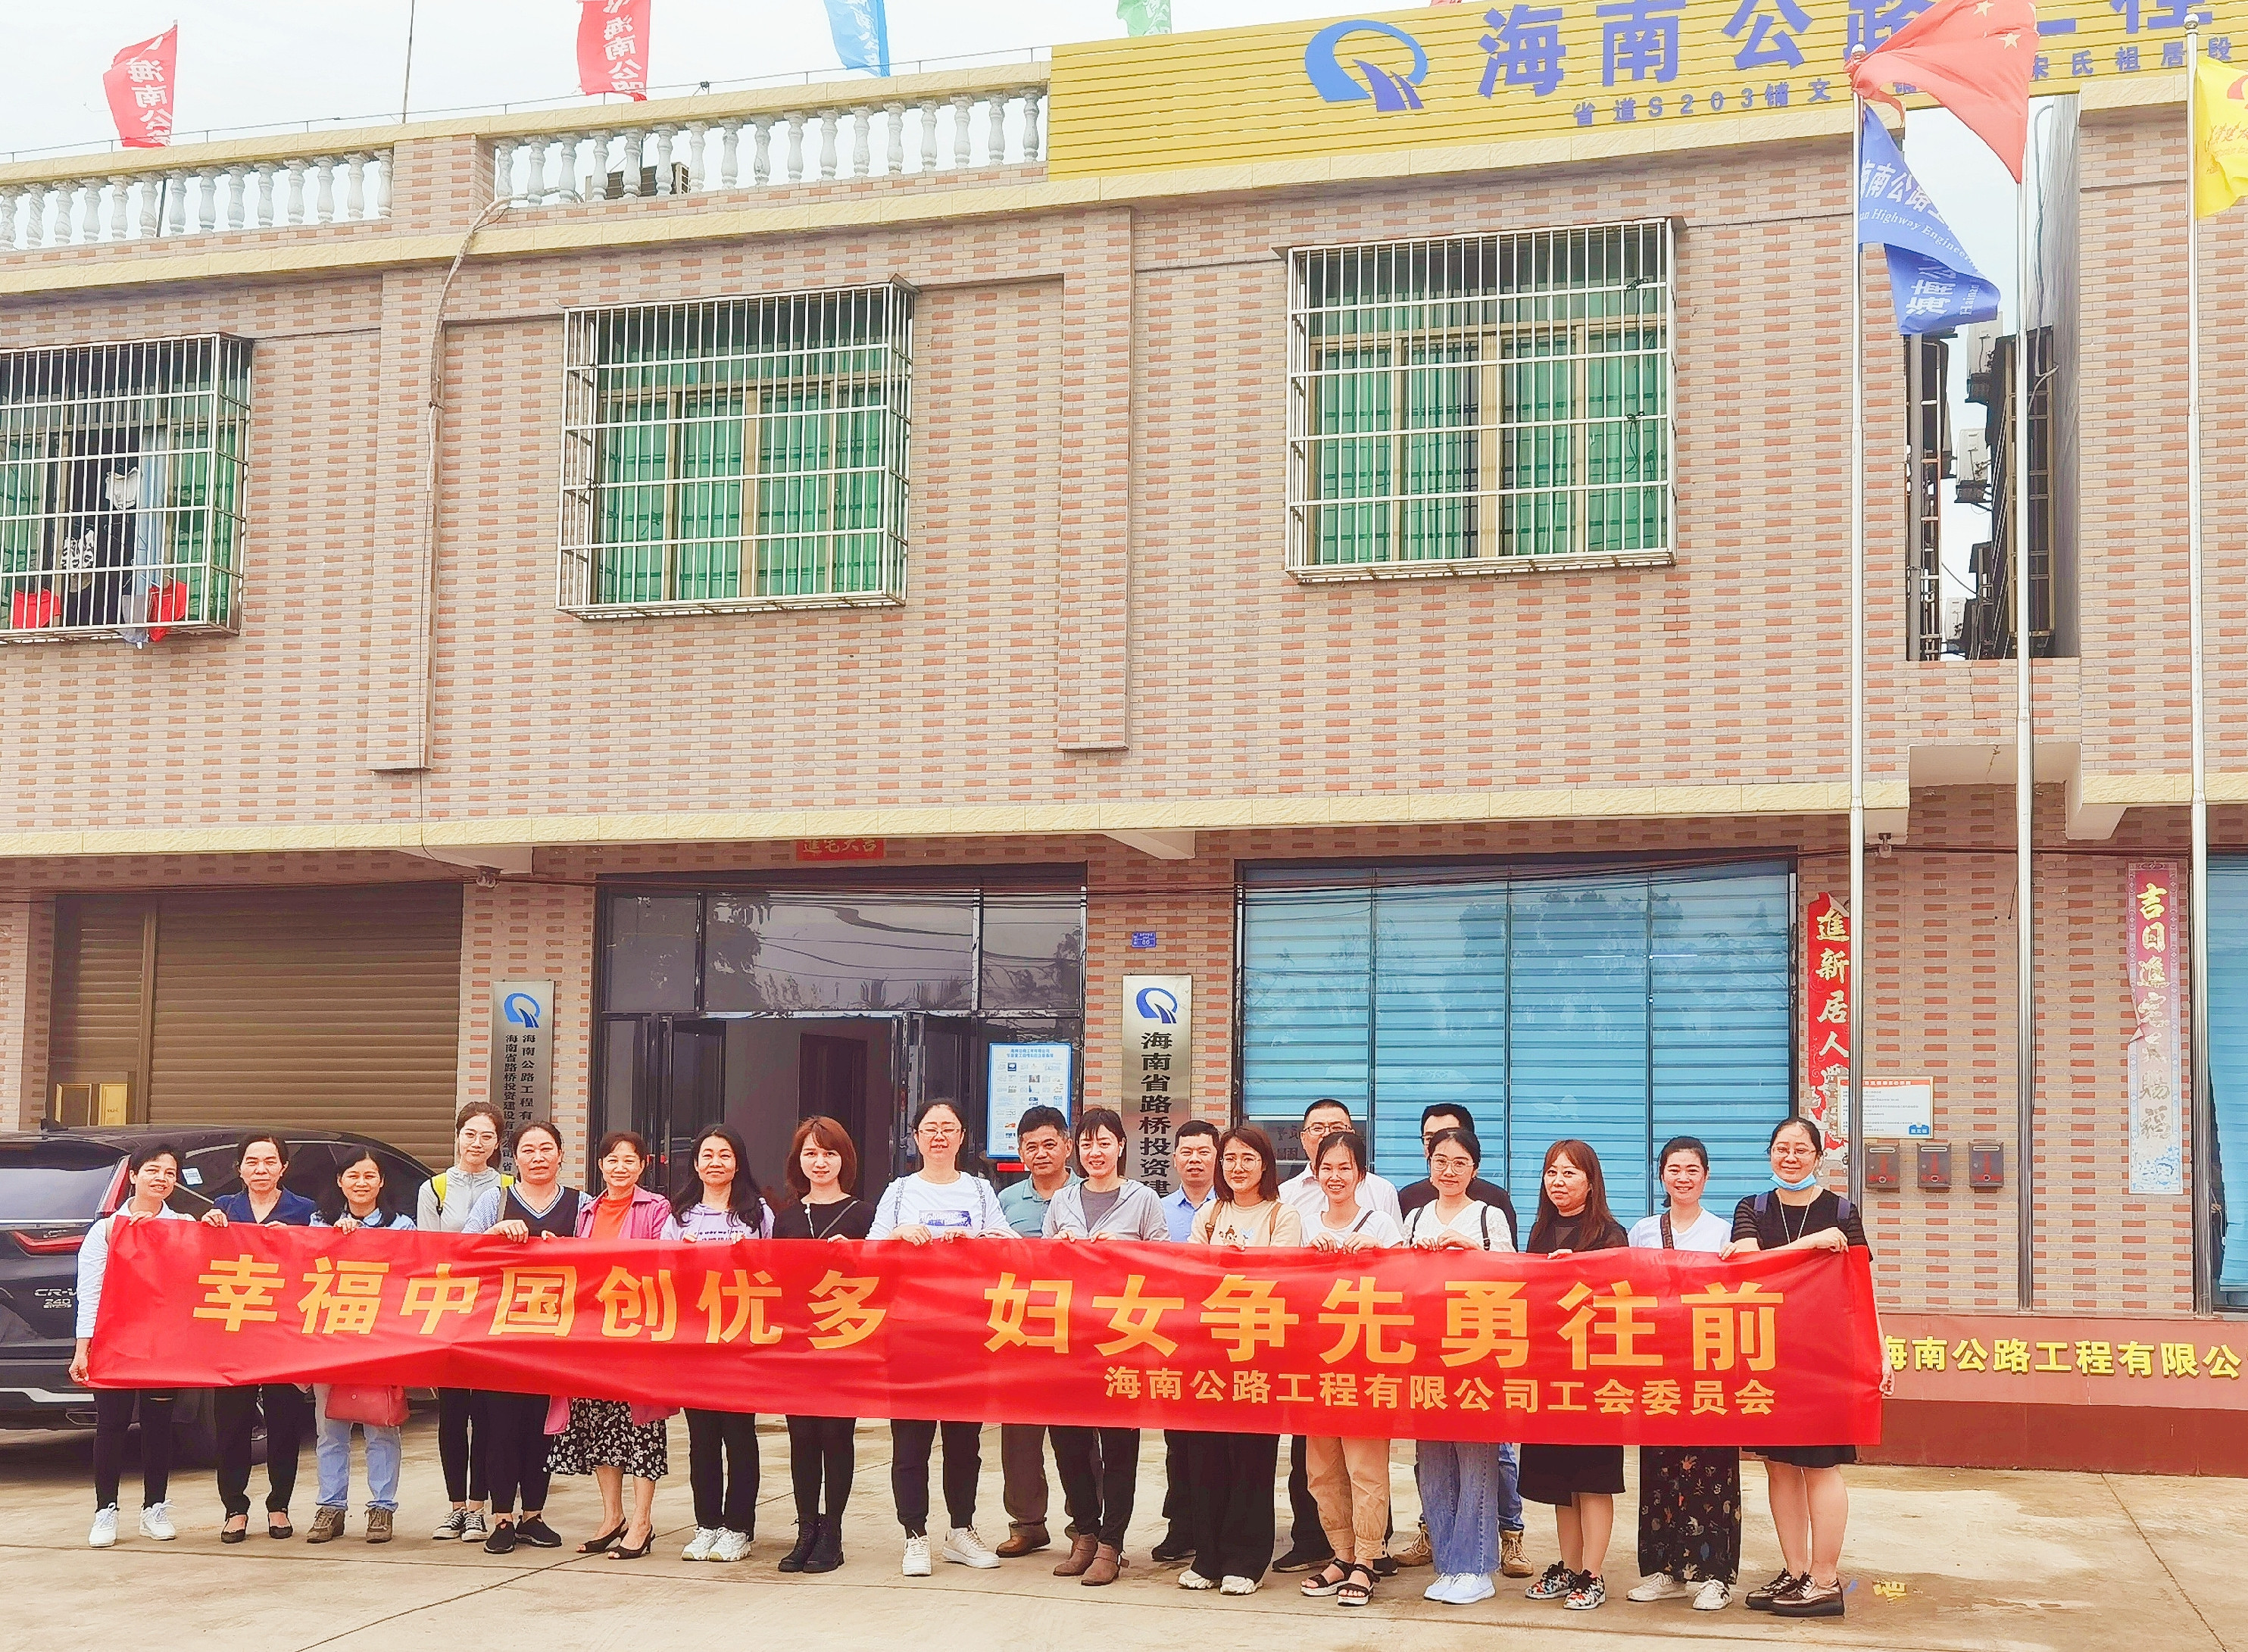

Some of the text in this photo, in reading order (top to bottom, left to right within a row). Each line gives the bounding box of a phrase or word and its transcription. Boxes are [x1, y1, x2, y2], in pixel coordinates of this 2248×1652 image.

[1872, 208, 1922, 230] Highway
[192, 1254, 1786, 1372] 幸福中国创优多 妇女争先勇往前
[1104, 1365, 1775, 1416] 海南公路工程有限公司工会委员会
